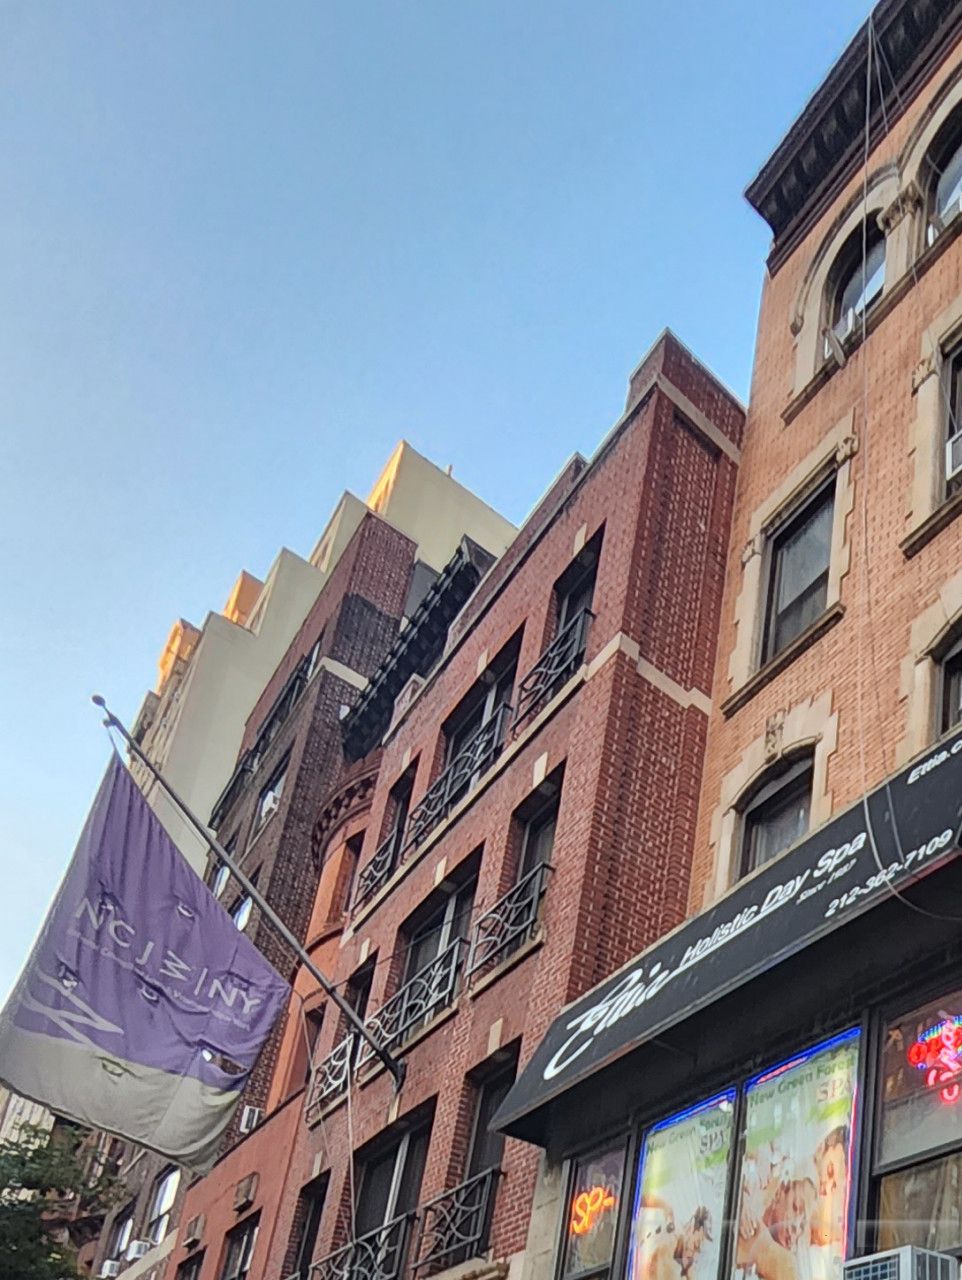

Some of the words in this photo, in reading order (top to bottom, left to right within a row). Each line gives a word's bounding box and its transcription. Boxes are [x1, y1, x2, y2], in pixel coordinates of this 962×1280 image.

[681, 904, 759, 968] Holistic
[761, 869, 811, 915] Day
[813, 832, 867, 878] Spa
